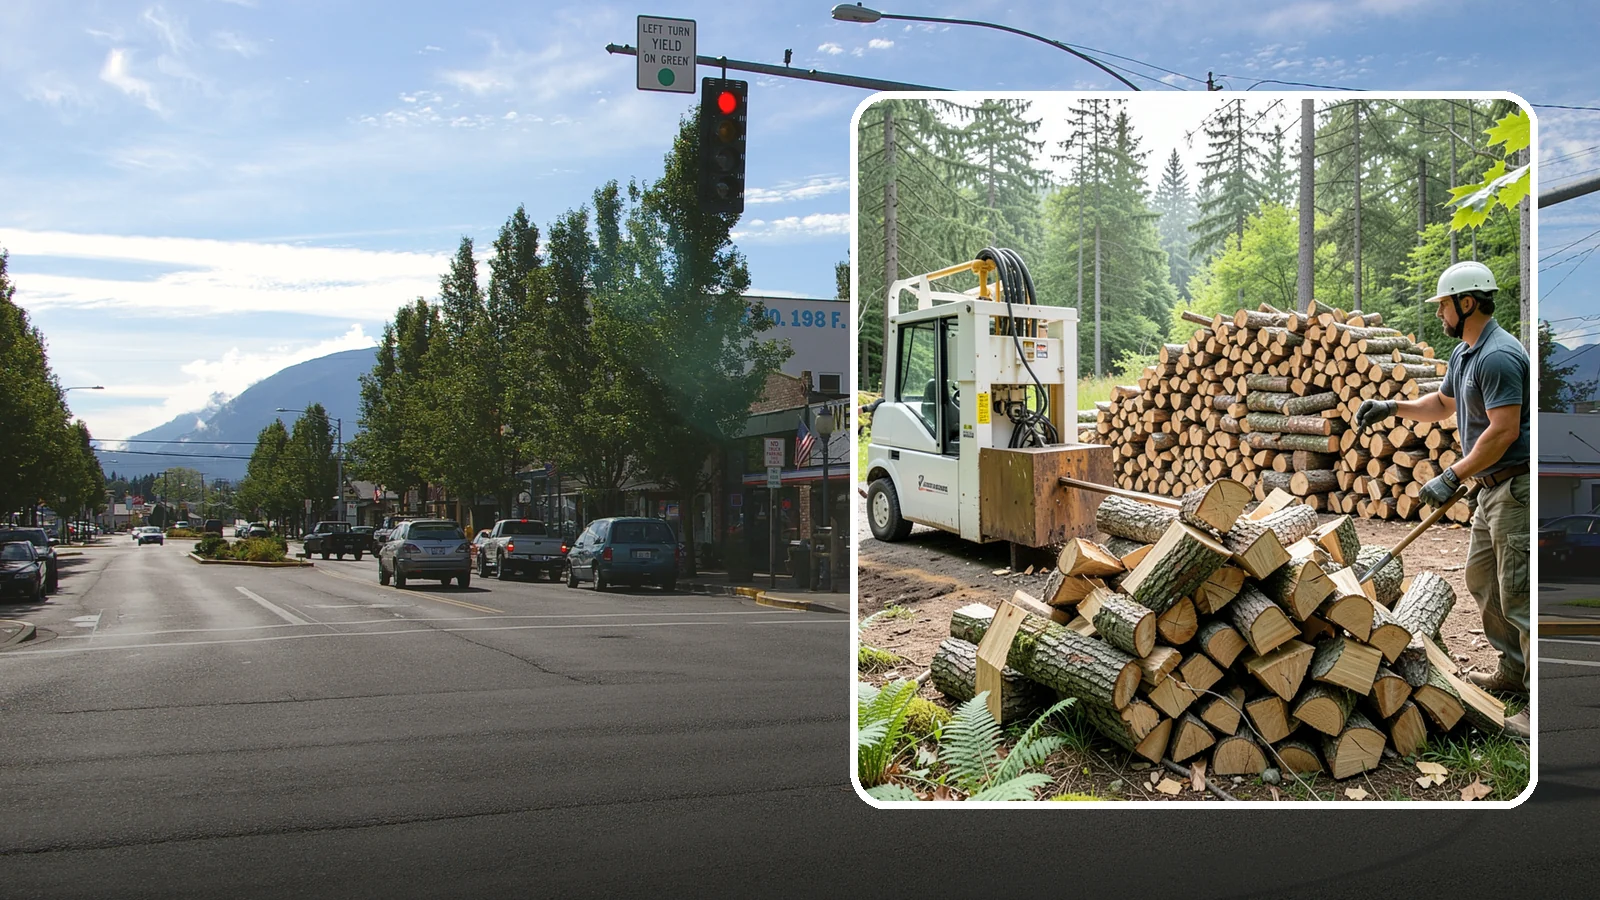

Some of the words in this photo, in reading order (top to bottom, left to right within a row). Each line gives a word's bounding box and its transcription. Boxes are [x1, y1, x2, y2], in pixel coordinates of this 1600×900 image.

[643, 23, 663, 34] LEFT
[668, 25, 690, 36] TURN
[652, 38, 682, 52] YIELD
[644, 53, 656, 64] ON
[661, 54, 689, 66] GREEN
[791, 309, 826, 328] 198
[831, 311, 847, 329] F.
